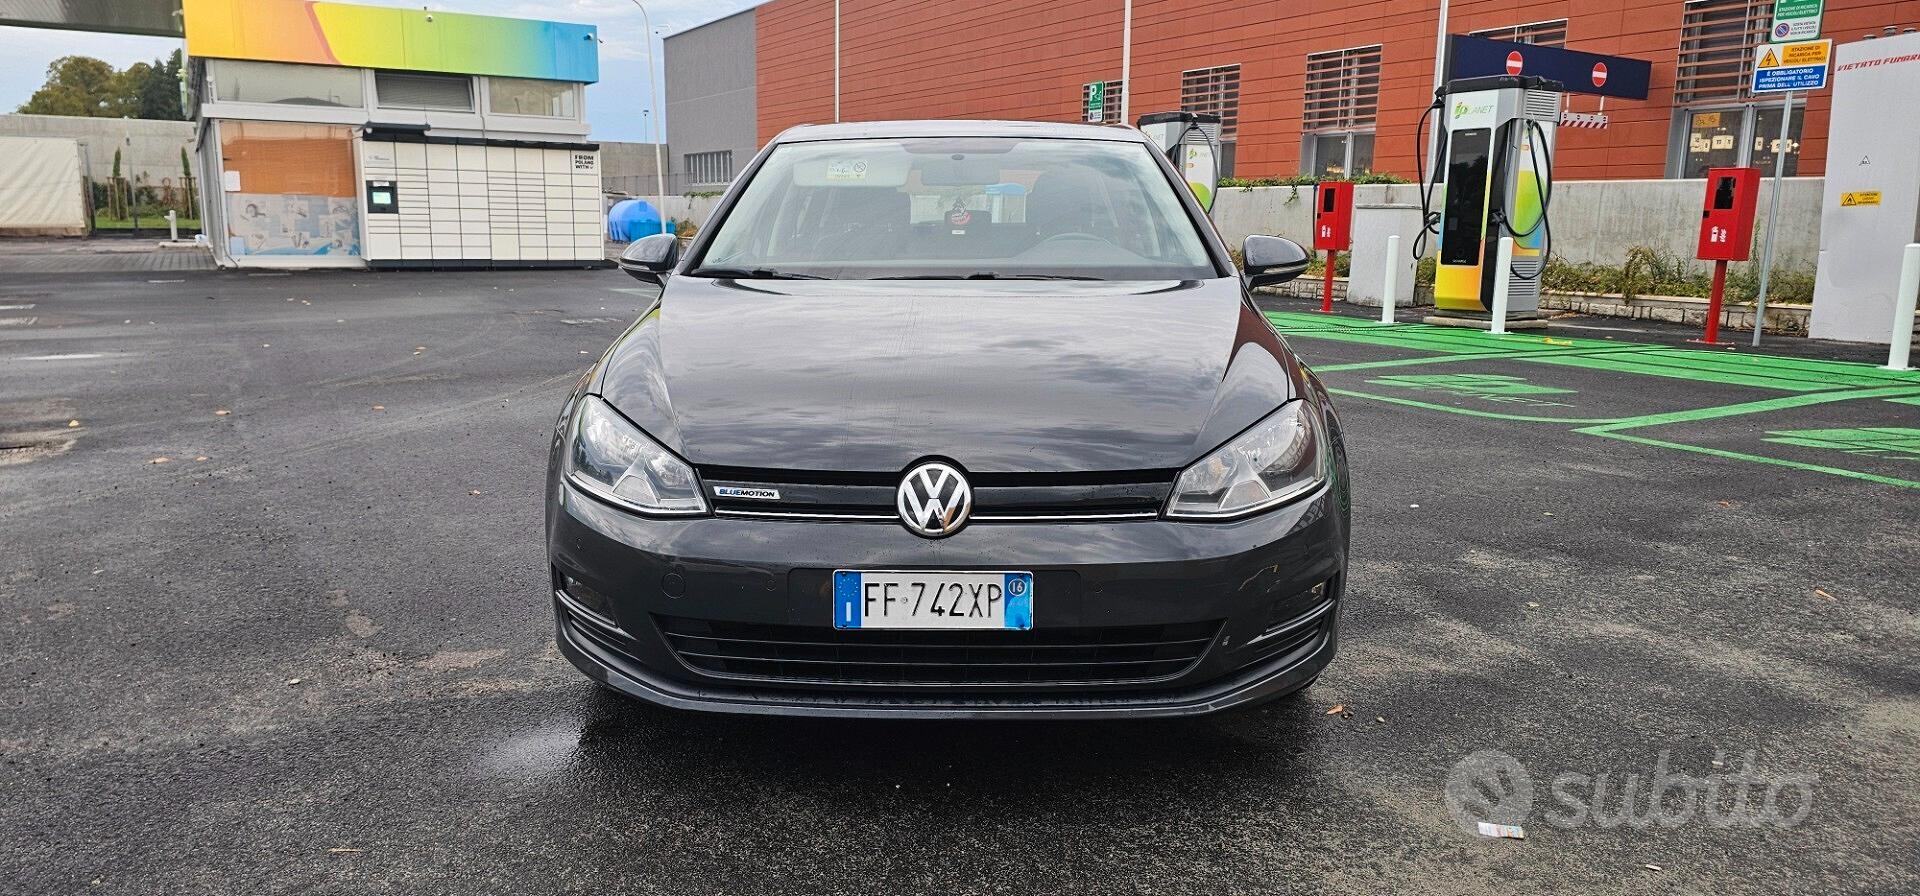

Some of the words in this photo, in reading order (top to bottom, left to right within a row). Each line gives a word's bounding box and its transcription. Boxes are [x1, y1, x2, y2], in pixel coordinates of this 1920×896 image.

[1837, 60, 1881, 71] VIETATO
[719, 488, 775, 497] BLUEMOTION
[1011, 583, 1022, 592] 16
[864, 583, 898, 616] FF
[911, 583, 1002, 617] 742XP
